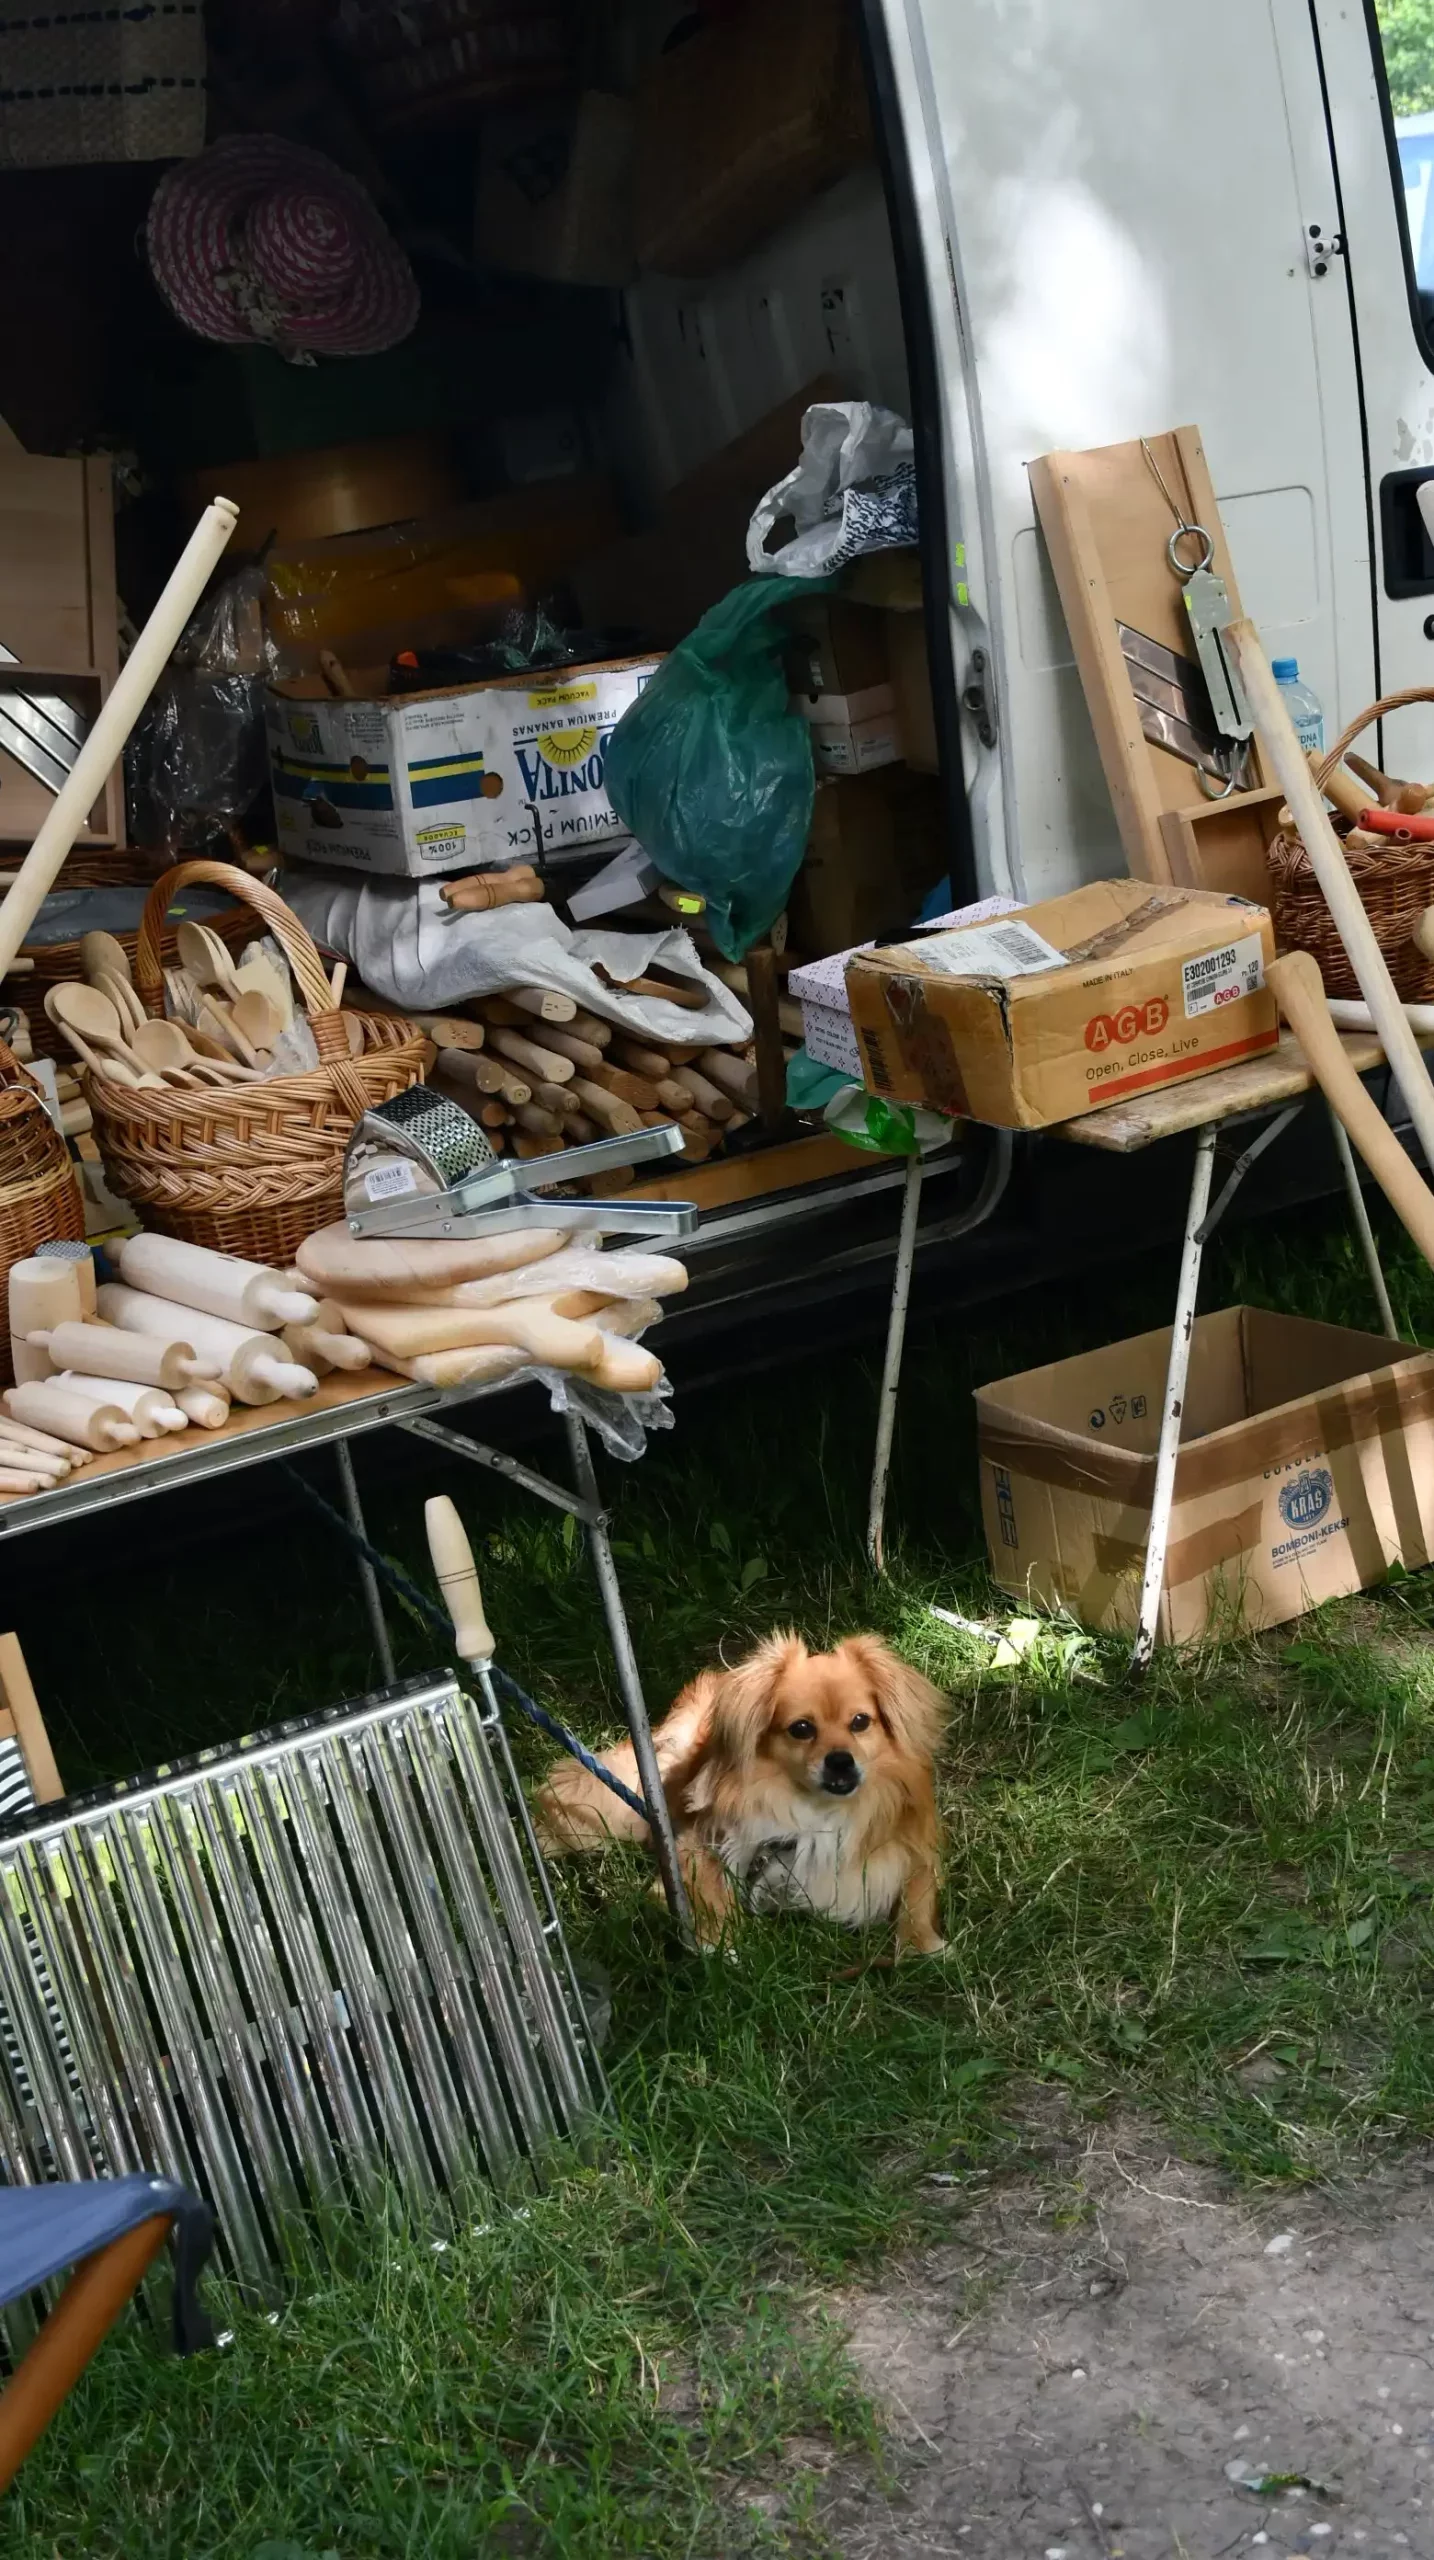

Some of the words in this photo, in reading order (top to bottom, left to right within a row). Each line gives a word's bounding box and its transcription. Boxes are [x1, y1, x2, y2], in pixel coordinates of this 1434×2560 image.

[537, 695, 557, 706] PACK
[558, 691, 590, 701] VACUUM
[567, 709, 617, 727] PREMIUM
[512, 719, 564, 737] BANANAS
[428, 842, 457, 855] 100%
[1184, 948, 1237, 983] E302001293
[1248, 959, 1259, 975] 120
[1082, 975, 1104, 988] MADE
[1104, 973, 1113, 983] IN
[1113, 967, 1134, 980] ITALY
[1215, 986, 1239, 1004] AGB
[1087, 999, 1167, 1050] AGB
[1085, 1061, 1124, 1080] Open,
[1128, 1047, 1168, 1067] Close,
[1172, 1036, 1199, 1054] Live
[1271, 1517, 1351, 1559] BOMBONI-KEKSI
